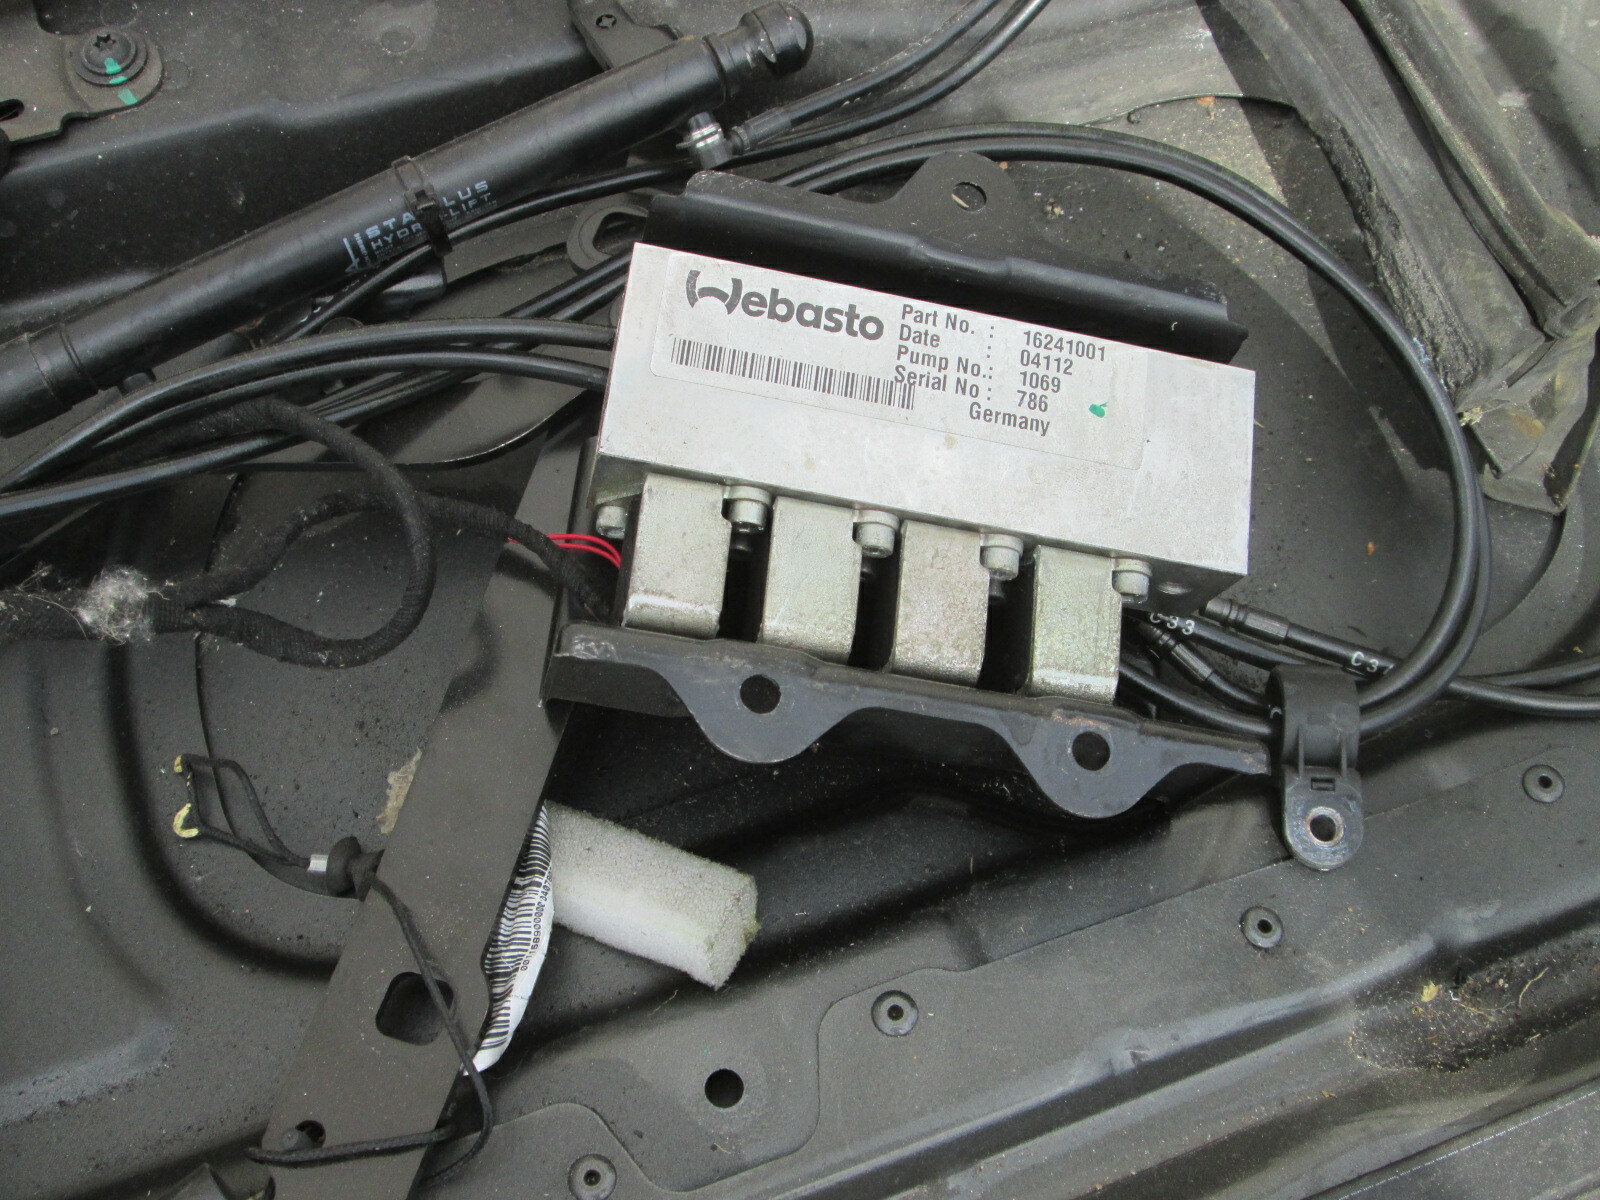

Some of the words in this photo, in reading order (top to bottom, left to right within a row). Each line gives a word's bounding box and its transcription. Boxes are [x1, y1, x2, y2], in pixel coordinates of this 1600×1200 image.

[365, 180, 489, 240] STALUS
[685, 269, 885, 341] Webasto
[899, 324, 941, 348] Date
[1019, 349, 1074, 376] 04112
[901, 303, 938, 326] Part
[945, 314, 976, 335] No.
[1023, 330, 1107, 362] 16241001
[894, 365, 947, 392] Serial
[1015, 390, 1049, 413] 786
[896, 345, 949, 372] Pump
[1018, 371, 1062, 394] 1069
[968, 402, 1051, 437] Germany
